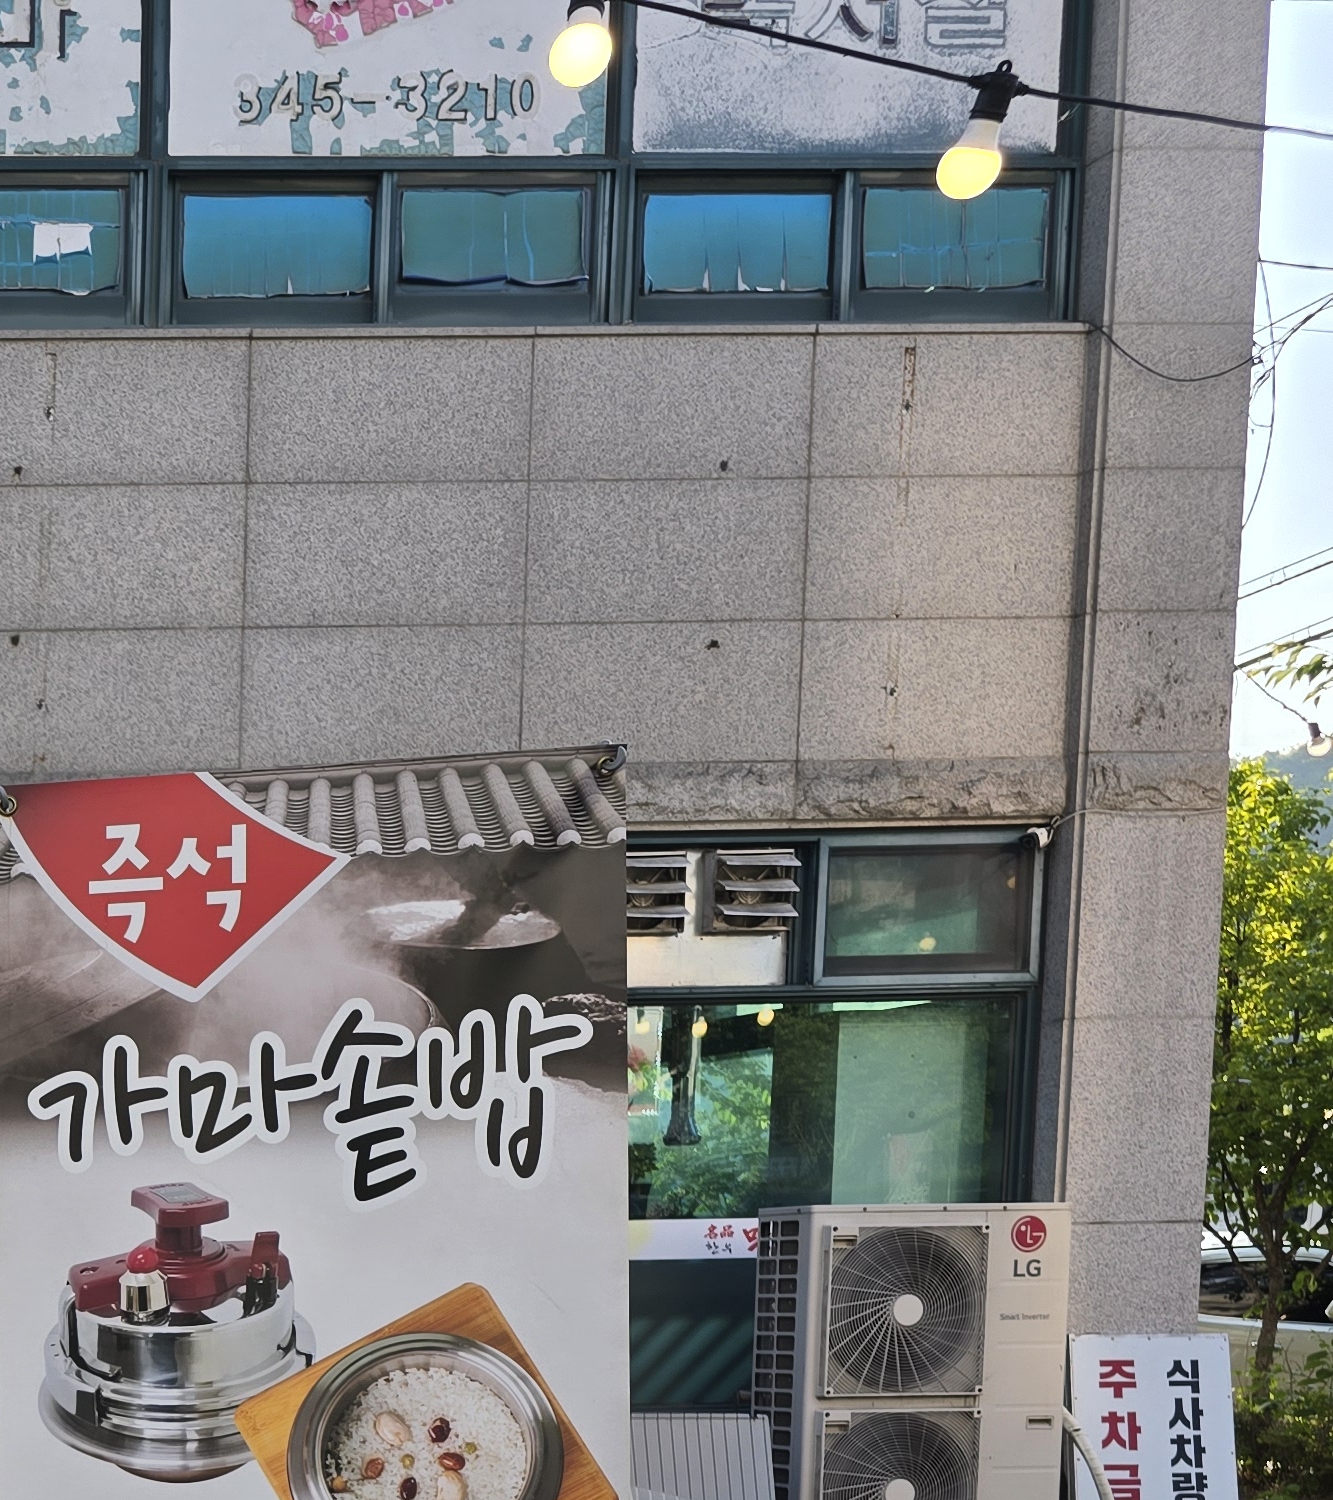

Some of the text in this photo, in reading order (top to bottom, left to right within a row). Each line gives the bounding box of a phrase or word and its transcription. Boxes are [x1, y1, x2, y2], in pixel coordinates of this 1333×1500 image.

[88, 822, 248, 944] 즉석
[35, 1000, 583, 1203] 가마솥밥
[1013, 1259, 1042, 1278] LG
[999, 1312, 1051, 1321] Smart Inverter
